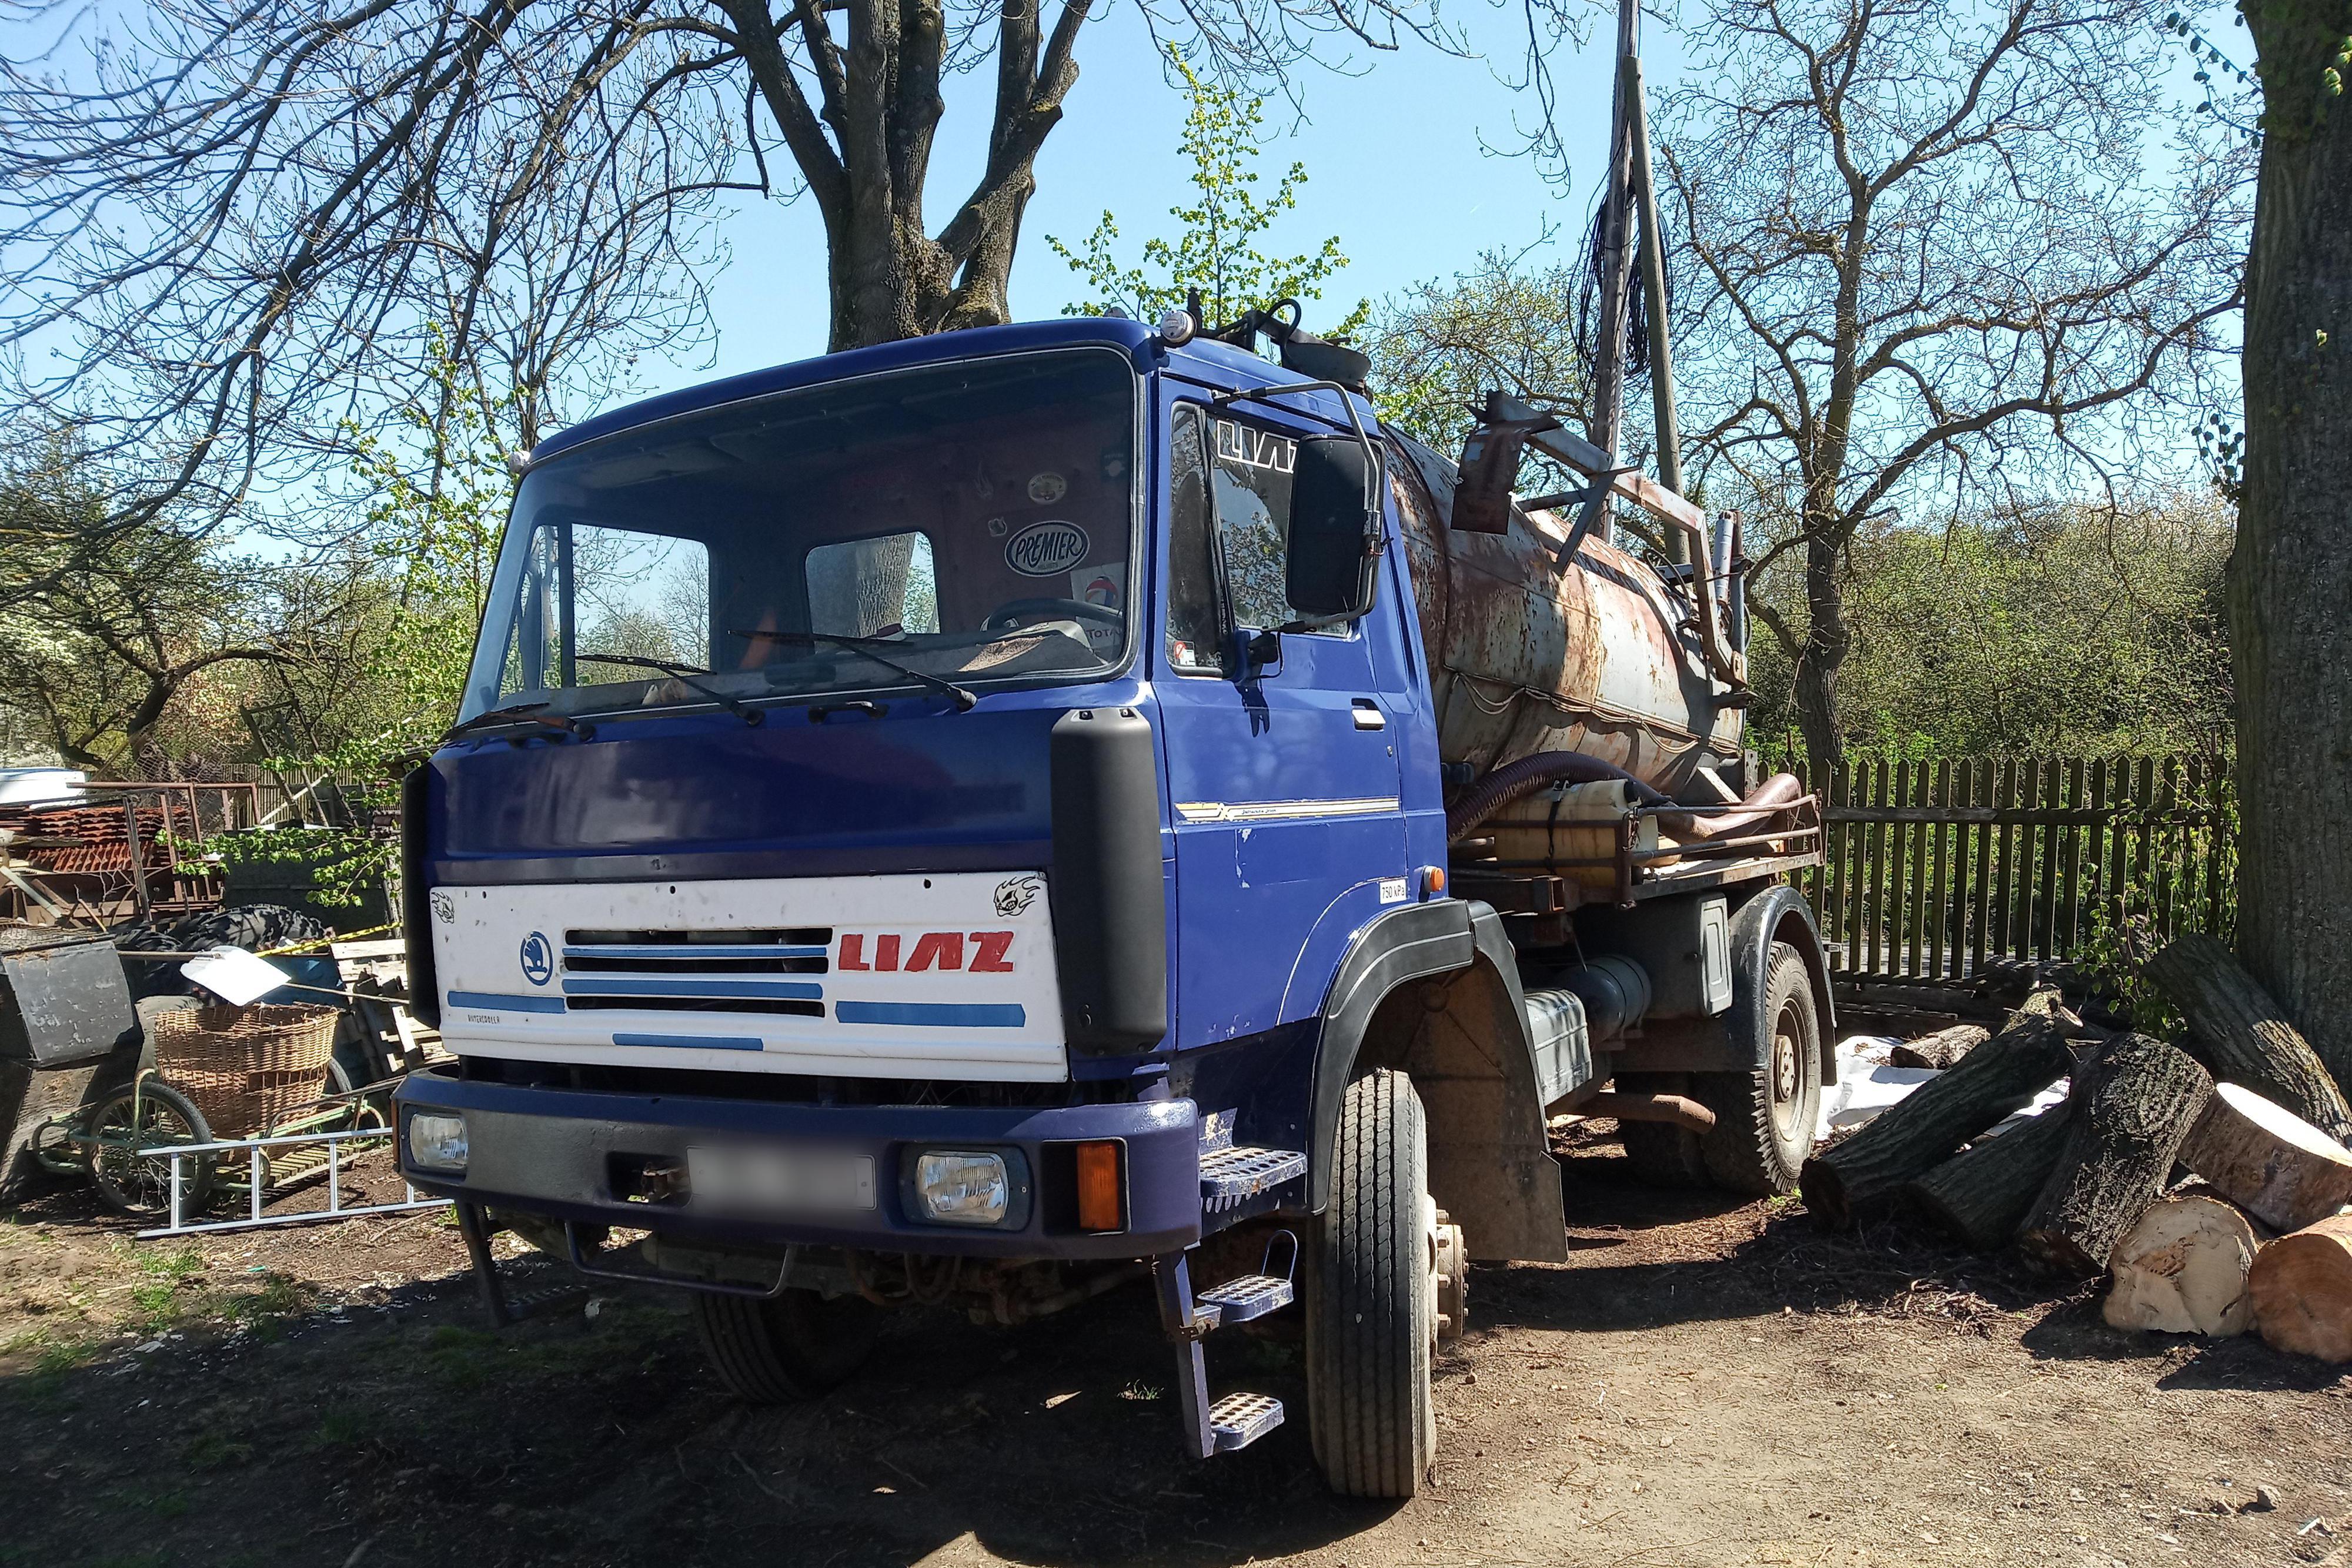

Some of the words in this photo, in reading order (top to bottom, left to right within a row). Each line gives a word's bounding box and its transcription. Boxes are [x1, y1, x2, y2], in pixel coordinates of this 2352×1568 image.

[1217, 420, 1299, 474] LIA
[1015, 531, 1084, 569] PREMIER
[1381, 886, 1392, 899] 750
[1394, 884, 1405, 897] kPa
[838, 931, 1014, 972] LIAZ
[467, 1014, 500, 1025] INTERCOOLER
